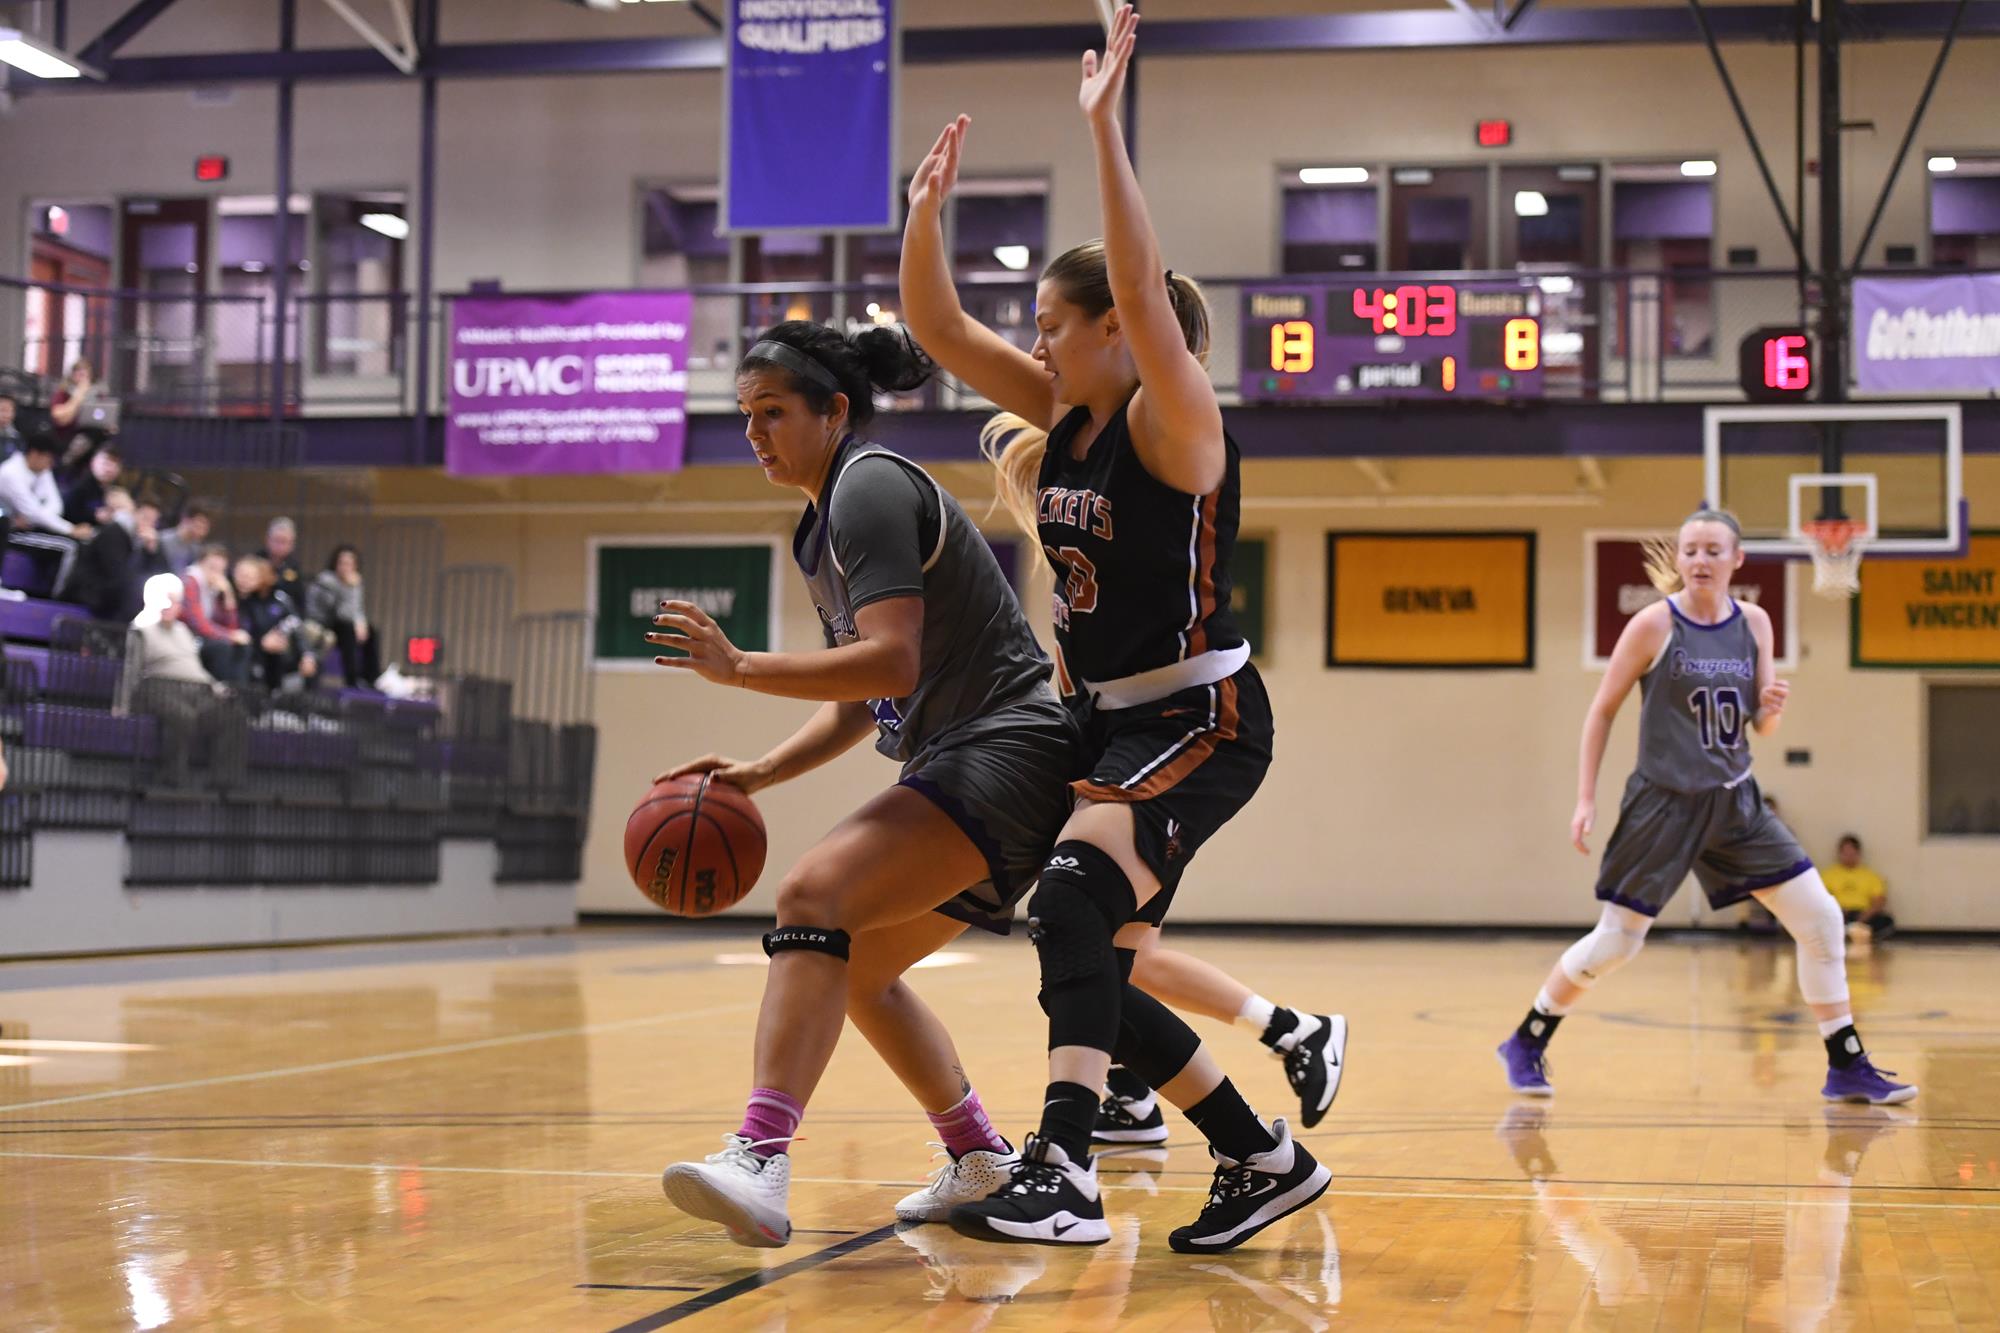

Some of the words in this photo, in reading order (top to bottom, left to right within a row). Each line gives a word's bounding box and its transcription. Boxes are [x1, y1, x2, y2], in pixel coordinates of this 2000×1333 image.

[738, 20, 886, 53] QUALIFIERS
[1353, 285, 1456, 336] 4:03
[663, 322, 686, 342] by
[1271, 321, 1313, 373] 13
[1504, 319, 1539, 371] 8
[453, 355, 583, 397] UPMC
[594, 354, 672, 373] SPORTS
[1358, 362, 1422, 391] period
[1442, 356, 1456, 392] 1
[1764, 336, 1809, 389] 16
[594, 373, 687, 393] MEDICINE
[1037, 486, 1113, 540] CKETS
[1922, 568, 1996, 595] SAINT
[1382, 586, 1478, 614] GENEVA
[1670, 647, 1754, 680] Cougars
[1687, 686, 1743, 750] 10
[770, 932, 827, 944] MUELLER
